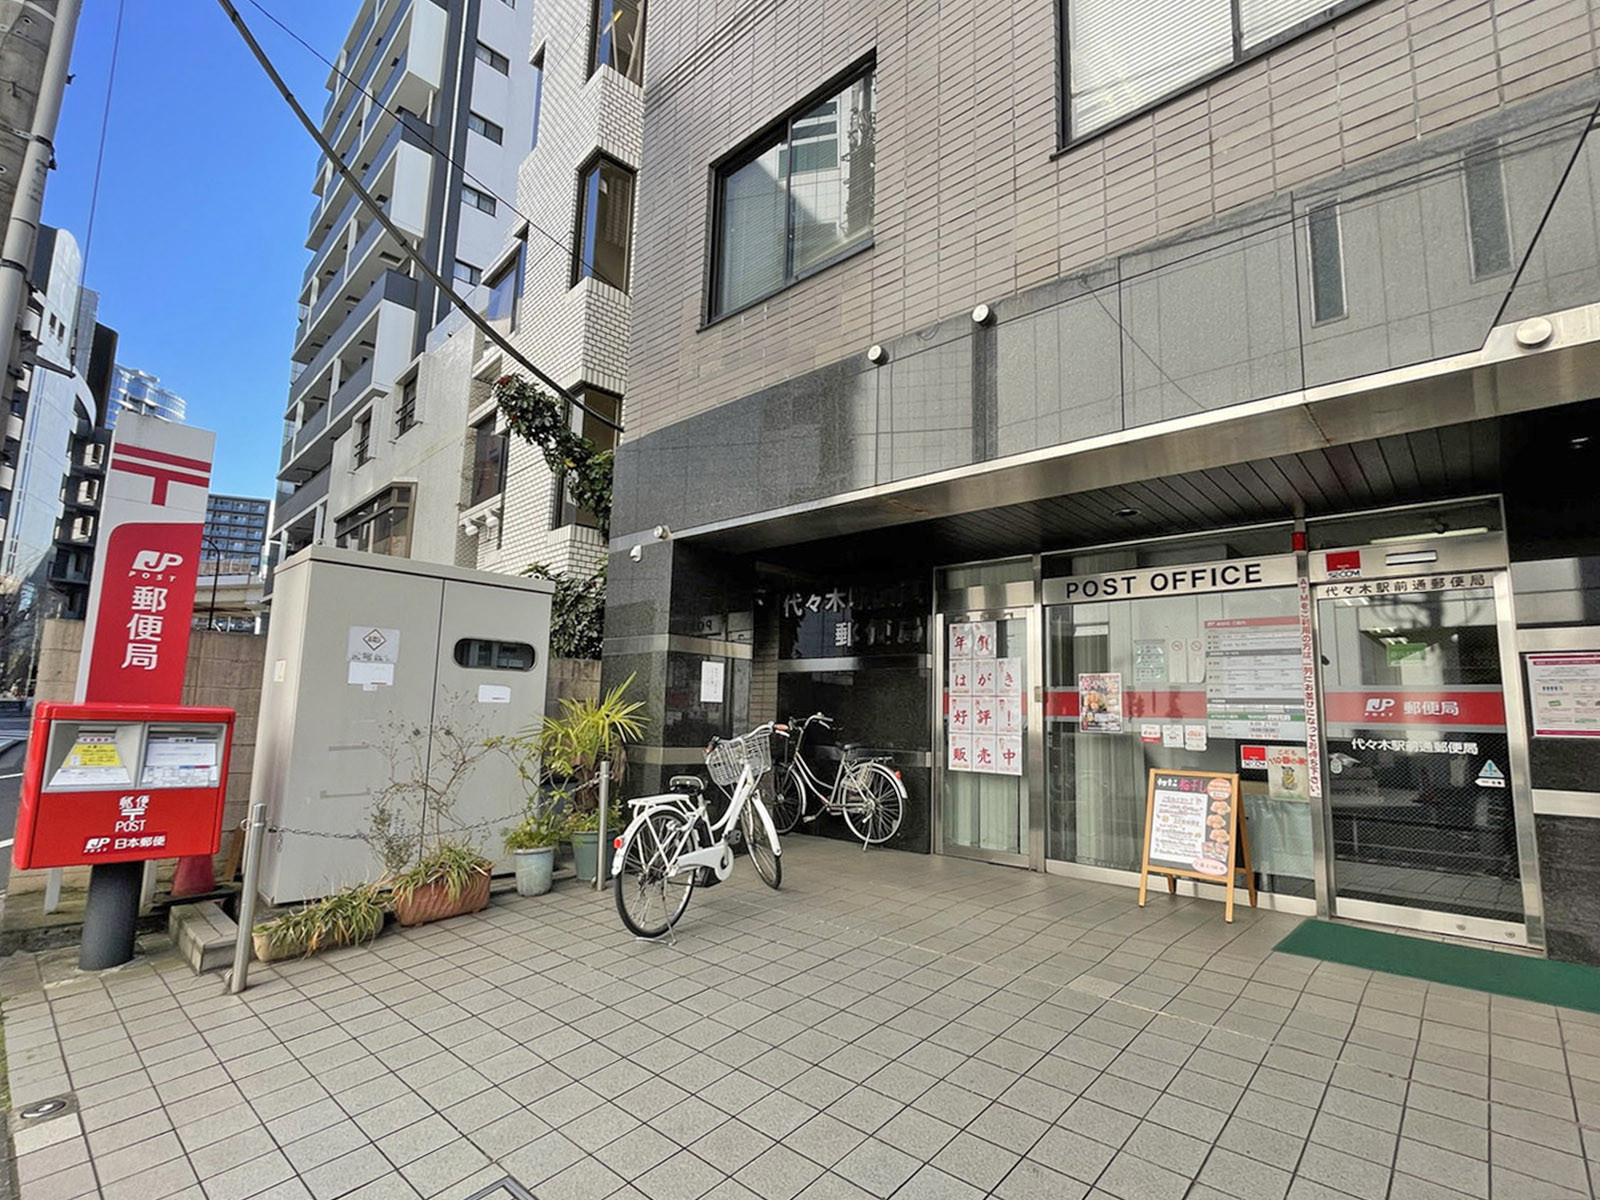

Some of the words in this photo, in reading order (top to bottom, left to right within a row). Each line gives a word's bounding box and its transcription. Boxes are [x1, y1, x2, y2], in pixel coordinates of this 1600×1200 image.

[128, 571, 176, 582] POST
[1066, 575, 1136, 599] POST
[1151, 563, 1262, 592] OFFICE
[1326, 574, 1485, 597] 代々木駅前通郵便局
[121, 585, 168, 671] 郵便局
[955, 672, 1013, 687] はがき
[1404, 701, 1459, 716] 郵便局
[1351, 738, 1479, 755] 代々木駅前通郵便局
[953, 746, 1016, 766] 販売中
[119, 795, 150, 809] 郵便
[115, 820, 146, 833] POST
[114, 835, 166, 849] 日本郵便
